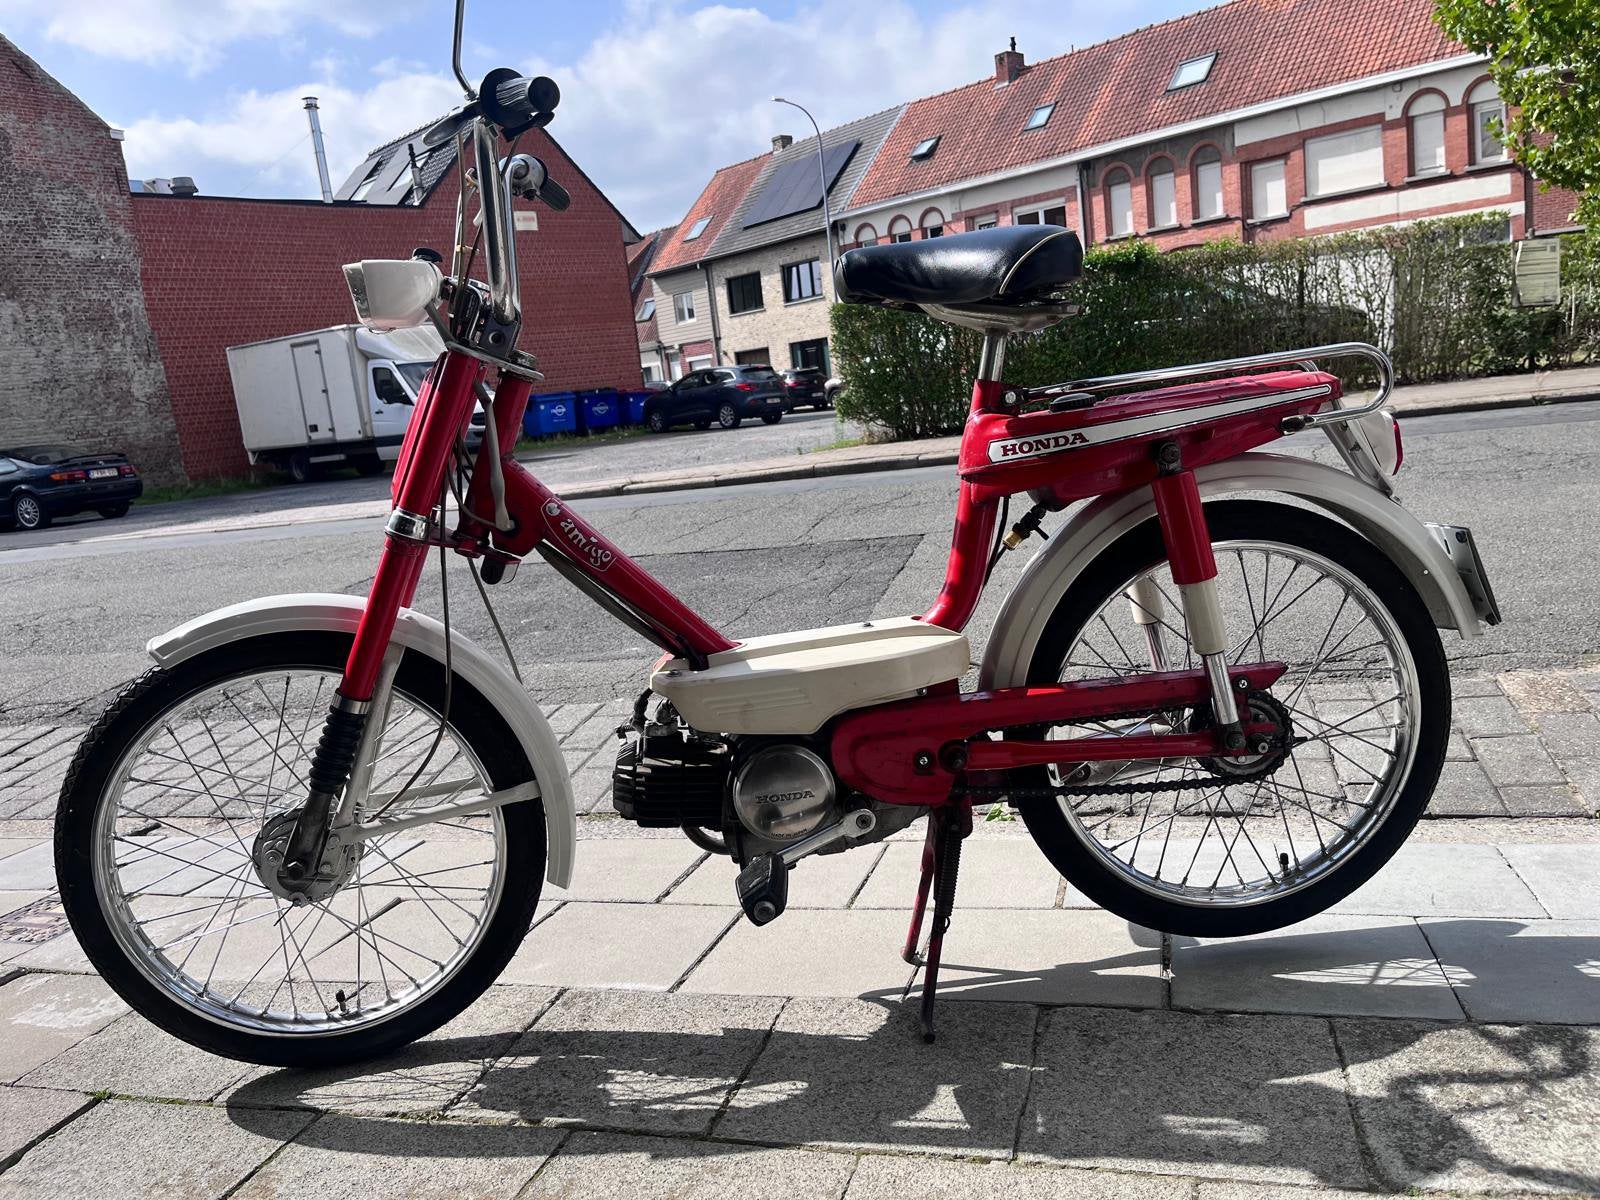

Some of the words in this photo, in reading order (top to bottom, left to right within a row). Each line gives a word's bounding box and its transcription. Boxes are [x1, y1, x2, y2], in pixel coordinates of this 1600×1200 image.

[1001, 432, 1089, 456] HONDA
[560, 518, 612, 566] amigo
[755, 790, 815, 804] HONDA
